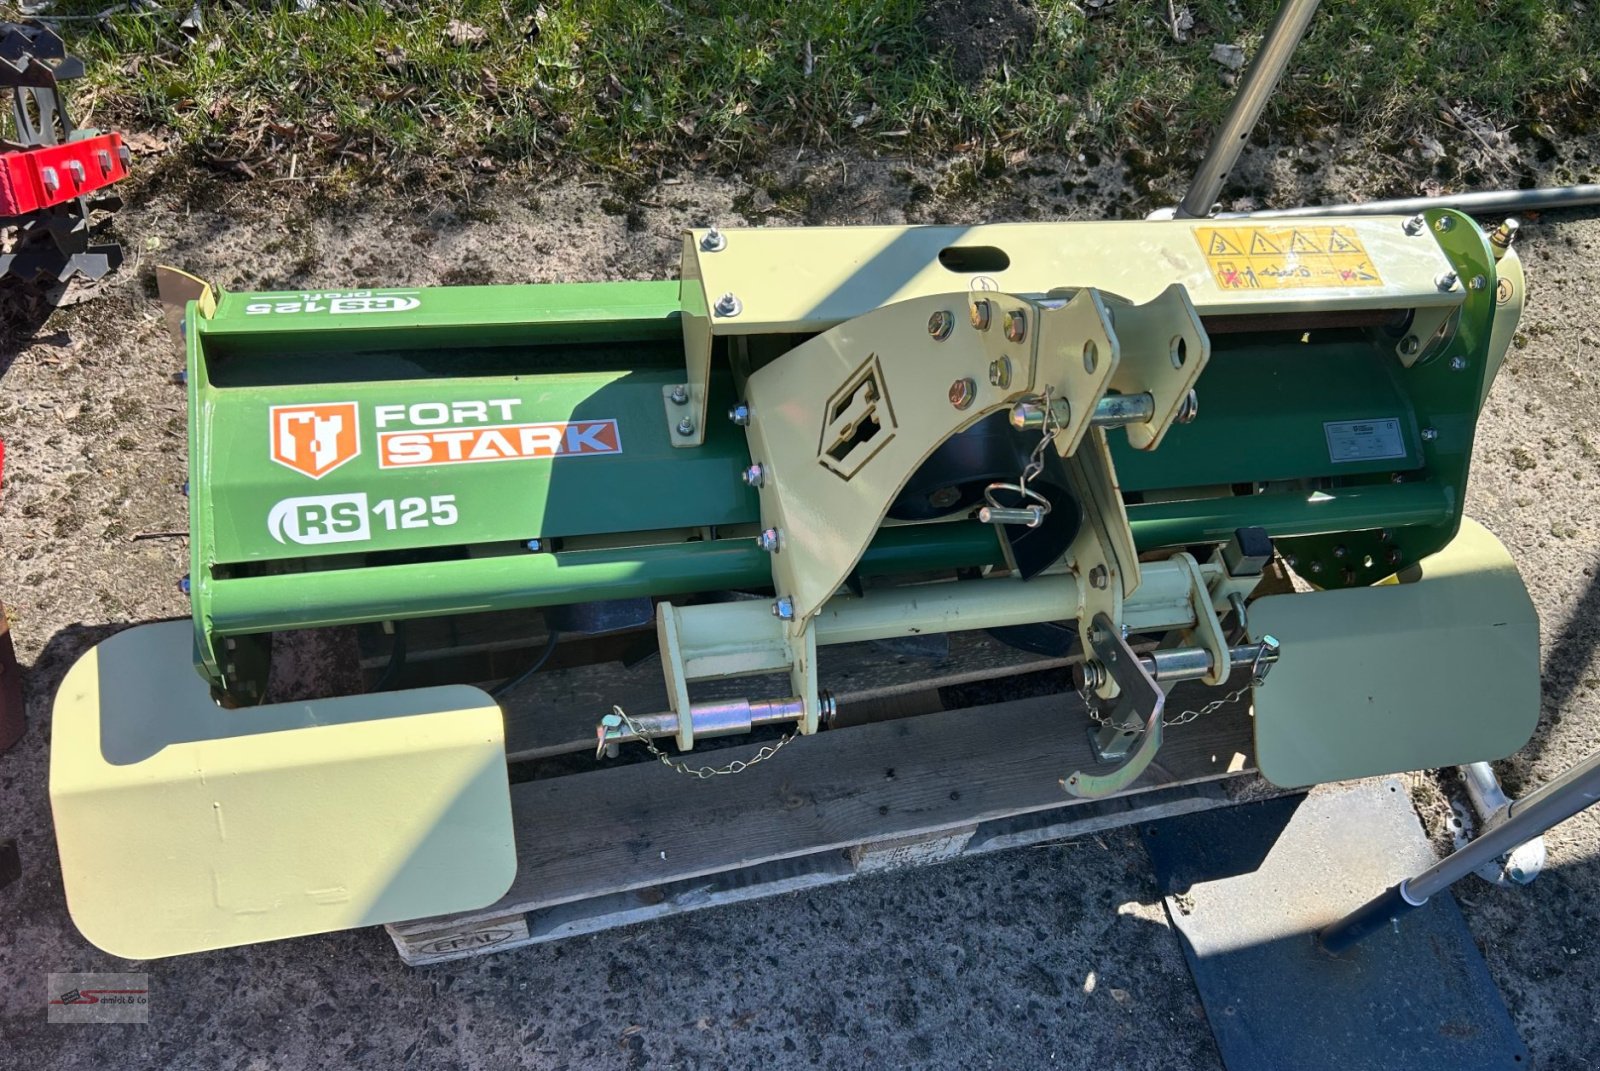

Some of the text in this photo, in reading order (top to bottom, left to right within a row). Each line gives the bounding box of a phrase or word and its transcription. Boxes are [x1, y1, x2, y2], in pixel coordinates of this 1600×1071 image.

[246, 299, 396, 314] RS 125
[375, 398, 522, 428] FORT
[387, 423, 613, 465] STARK
[296, 494, 458, 537] RS 125
